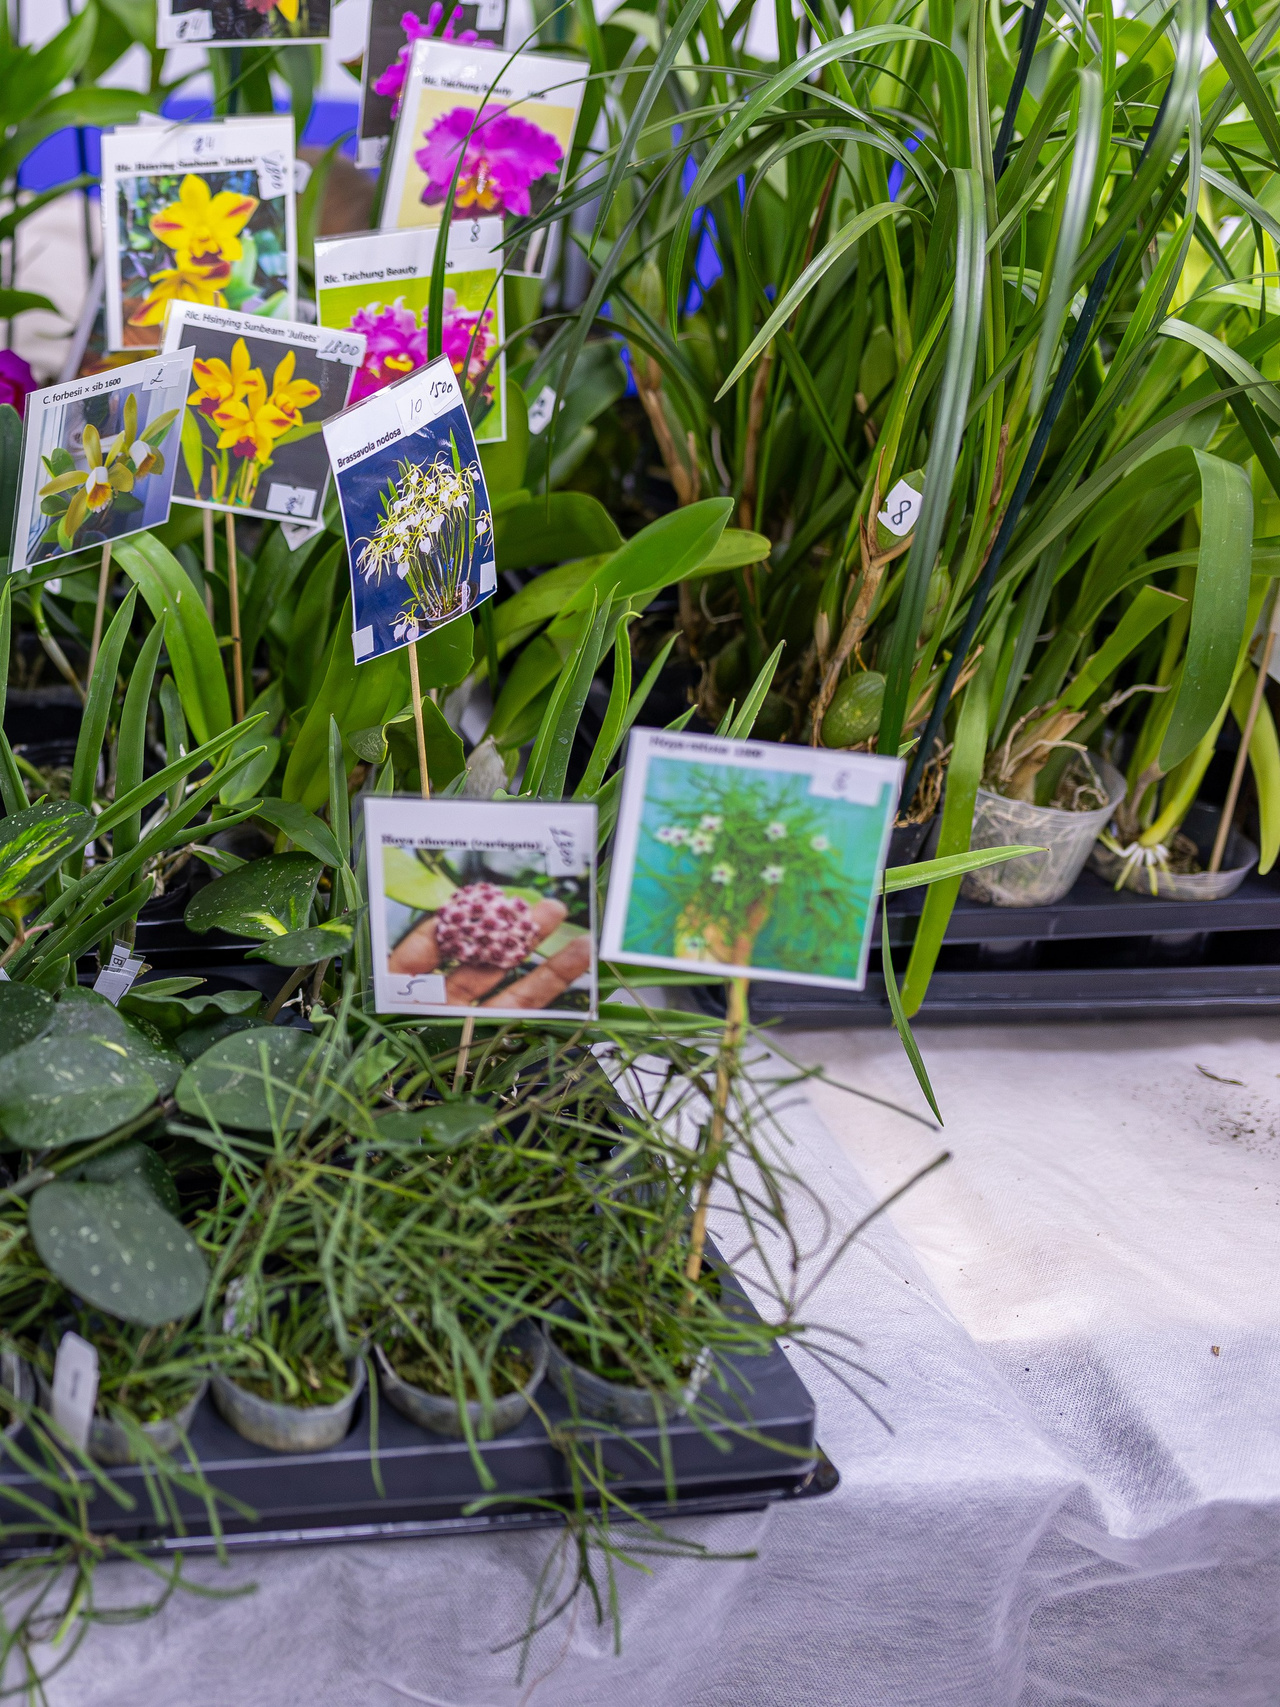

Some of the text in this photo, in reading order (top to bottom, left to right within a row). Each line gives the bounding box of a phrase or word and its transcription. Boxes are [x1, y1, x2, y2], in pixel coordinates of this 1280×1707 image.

[481, 82, 512, 96] Bauty
[324, 275, 340, 284] Rlc.
[343, 269, 384, 283] Taichung
[386, 266, 418, 277] Beauty
[185, 310, 200, 321] Rlc.
[202, 314, 242, 331] Hsinying
[244, 321, 285, 337] Sunbeam
[43, 395, 51, 405] C.
[52, 386, 83, 402] forbesii
[92, 383, 104, 392] sib
[105, 377, 122, 388] 1600
[429, 381, 453, 398] 1500
[410, 398, 423, 420] 10
[337, 427, 402, 468] Brassavola nodosa
[891, 500, 912, 526] 8
